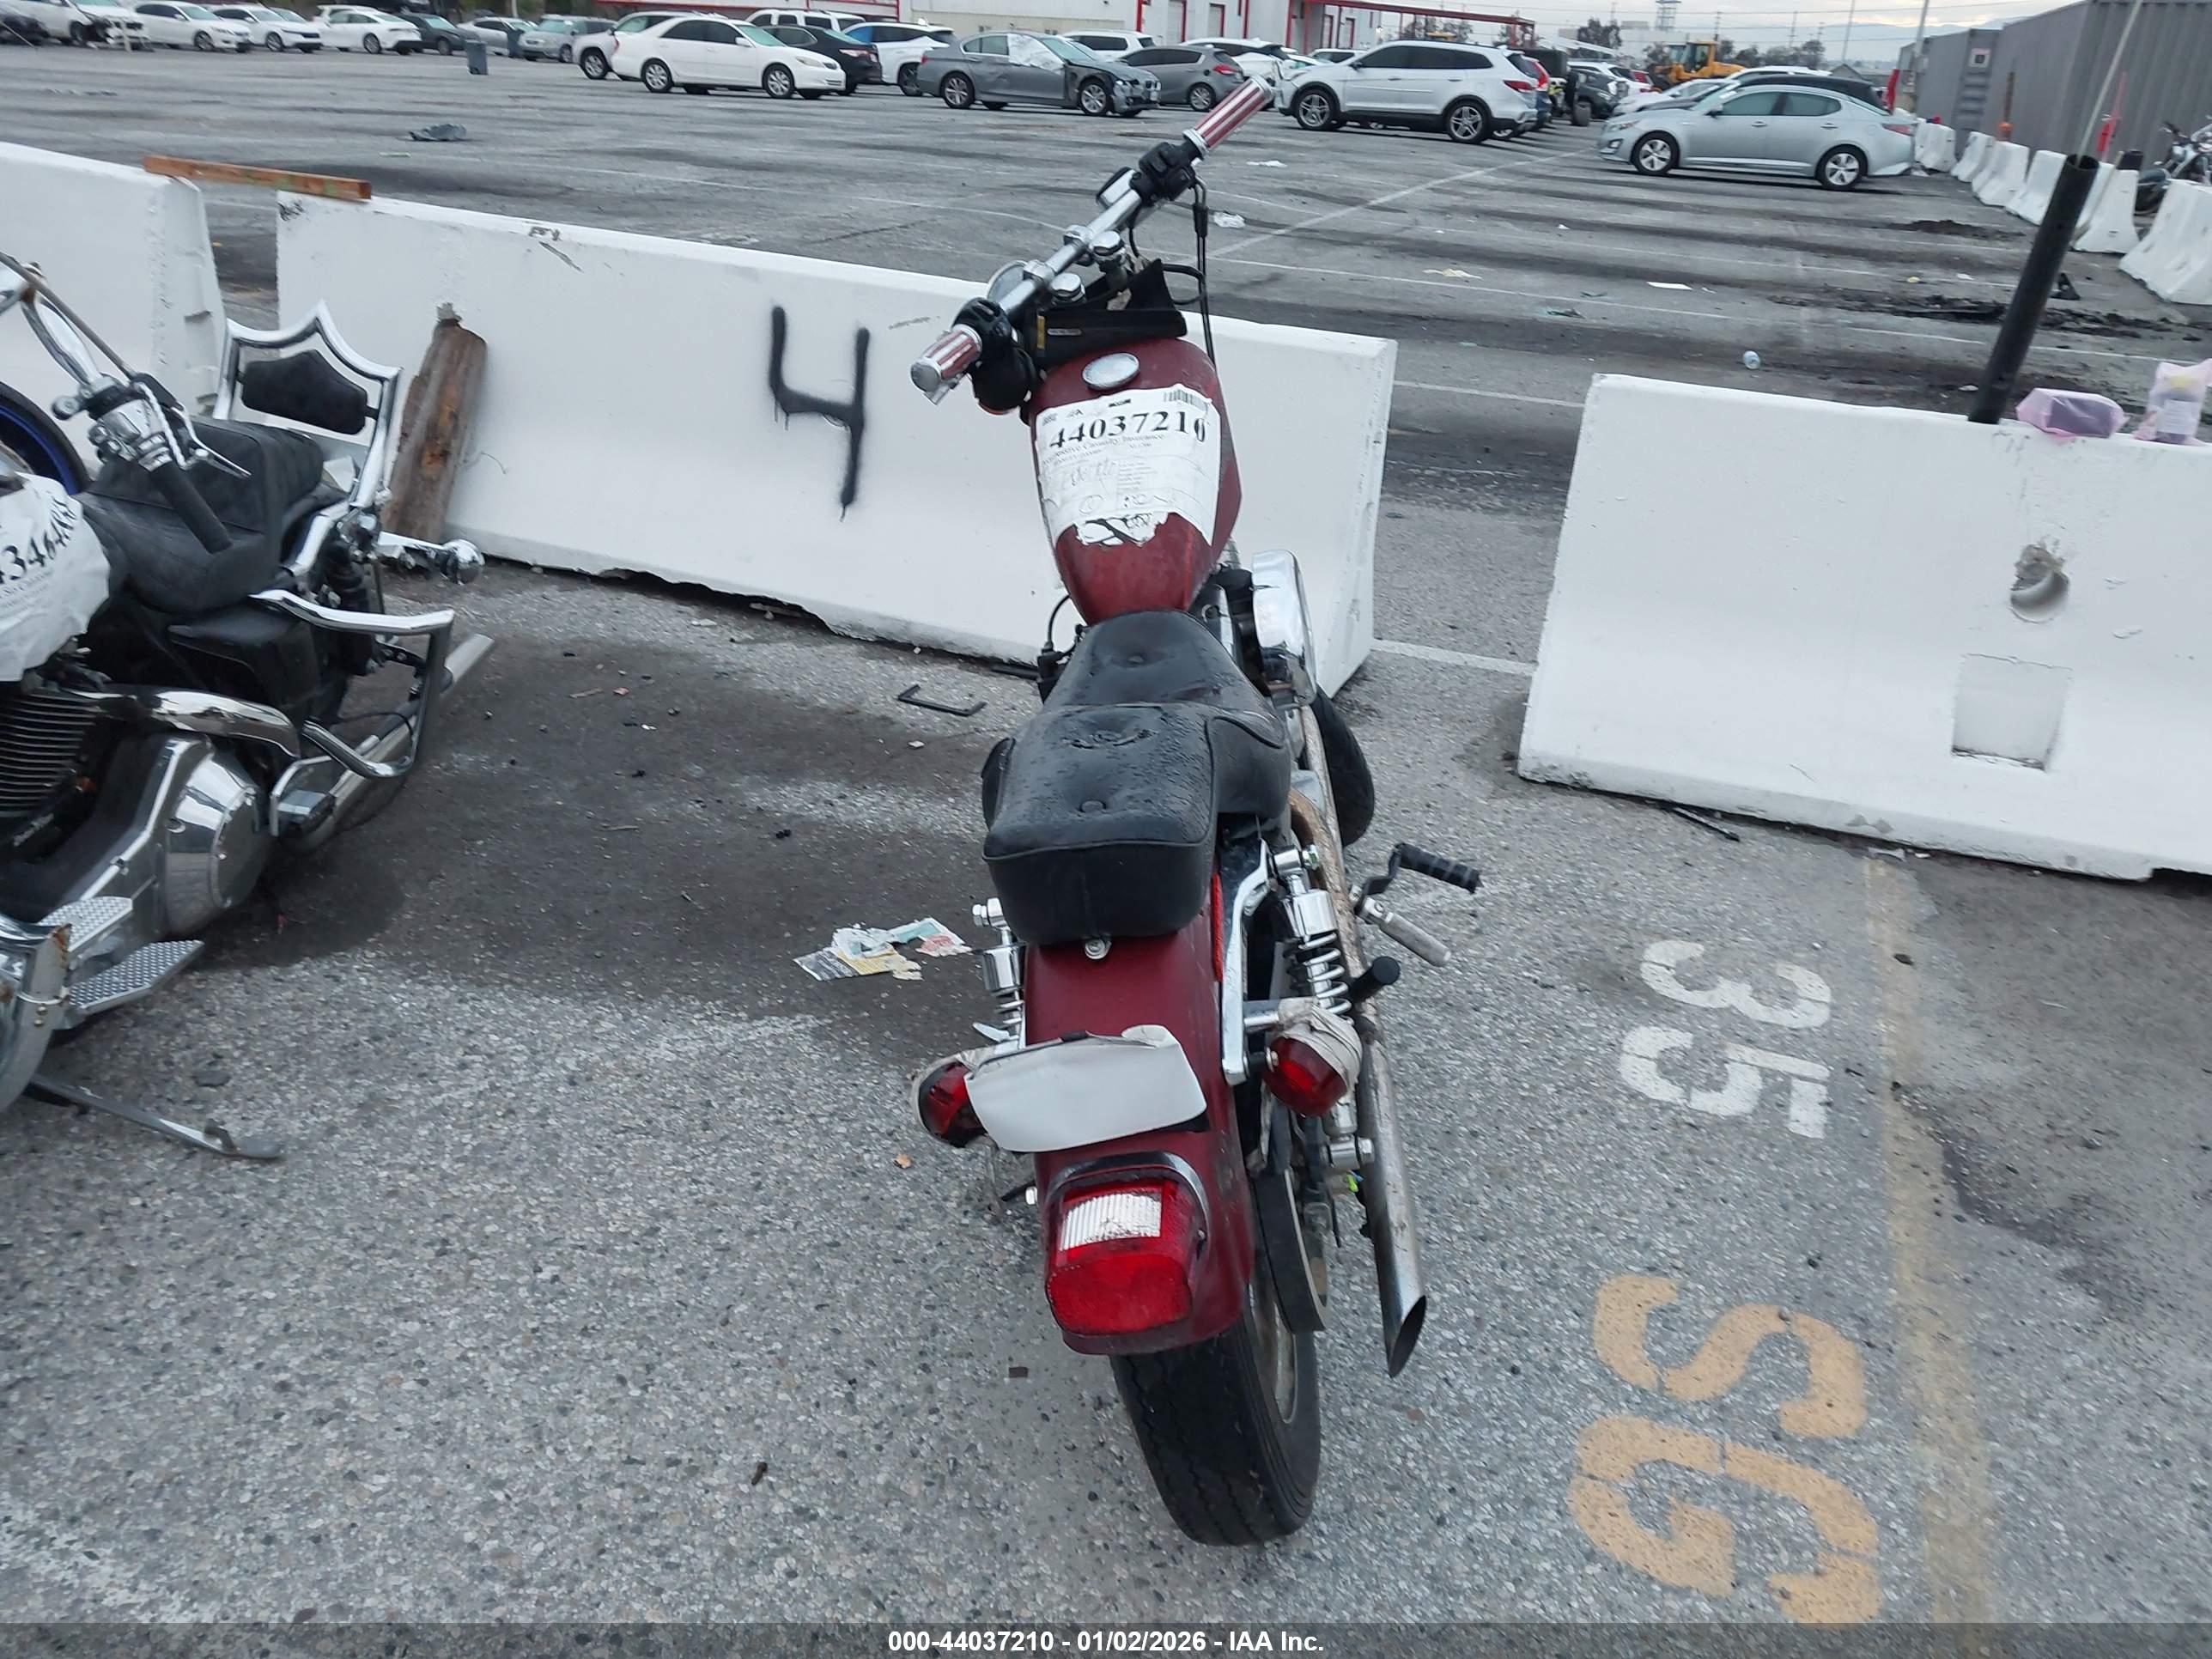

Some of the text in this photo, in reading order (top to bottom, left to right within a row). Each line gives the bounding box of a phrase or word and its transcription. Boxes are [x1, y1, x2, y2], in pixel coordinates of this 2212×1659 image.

[769, 304, 870, 520] 4
[1049, 411, 1206, 448] 44037210
[1568, 939, 1881, 1626] 35 SG
